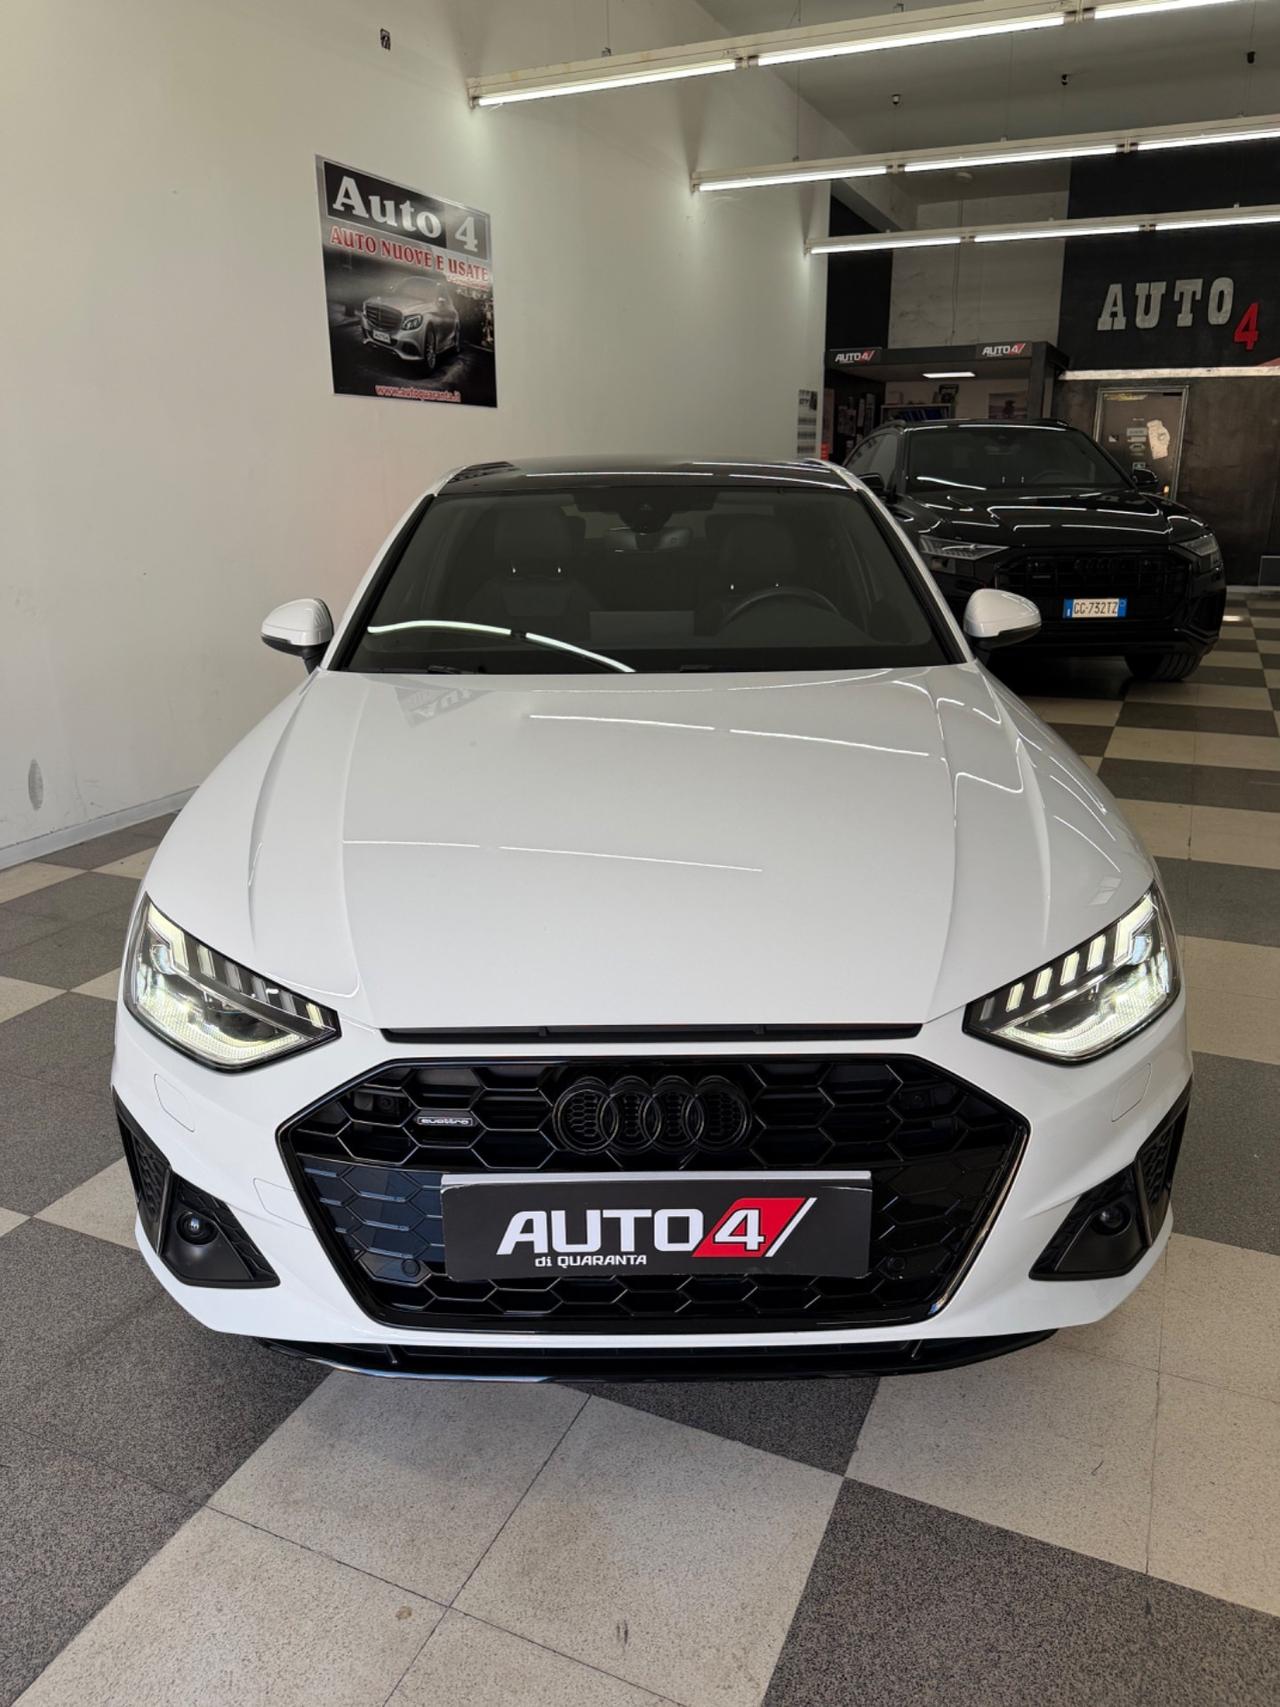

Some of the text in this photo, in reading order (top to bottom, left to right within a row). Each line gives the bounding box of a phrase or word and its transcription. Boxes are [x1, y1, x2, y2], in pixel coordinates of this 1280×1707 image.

[332, 176, 479, 252] Auto 4
[331, 226, 488, 281] AUTO NUOVE E USATE
[1097, 277, 1259, 350] AUTO 4
[534, 1255, 647, 1268] di QUARANTA
